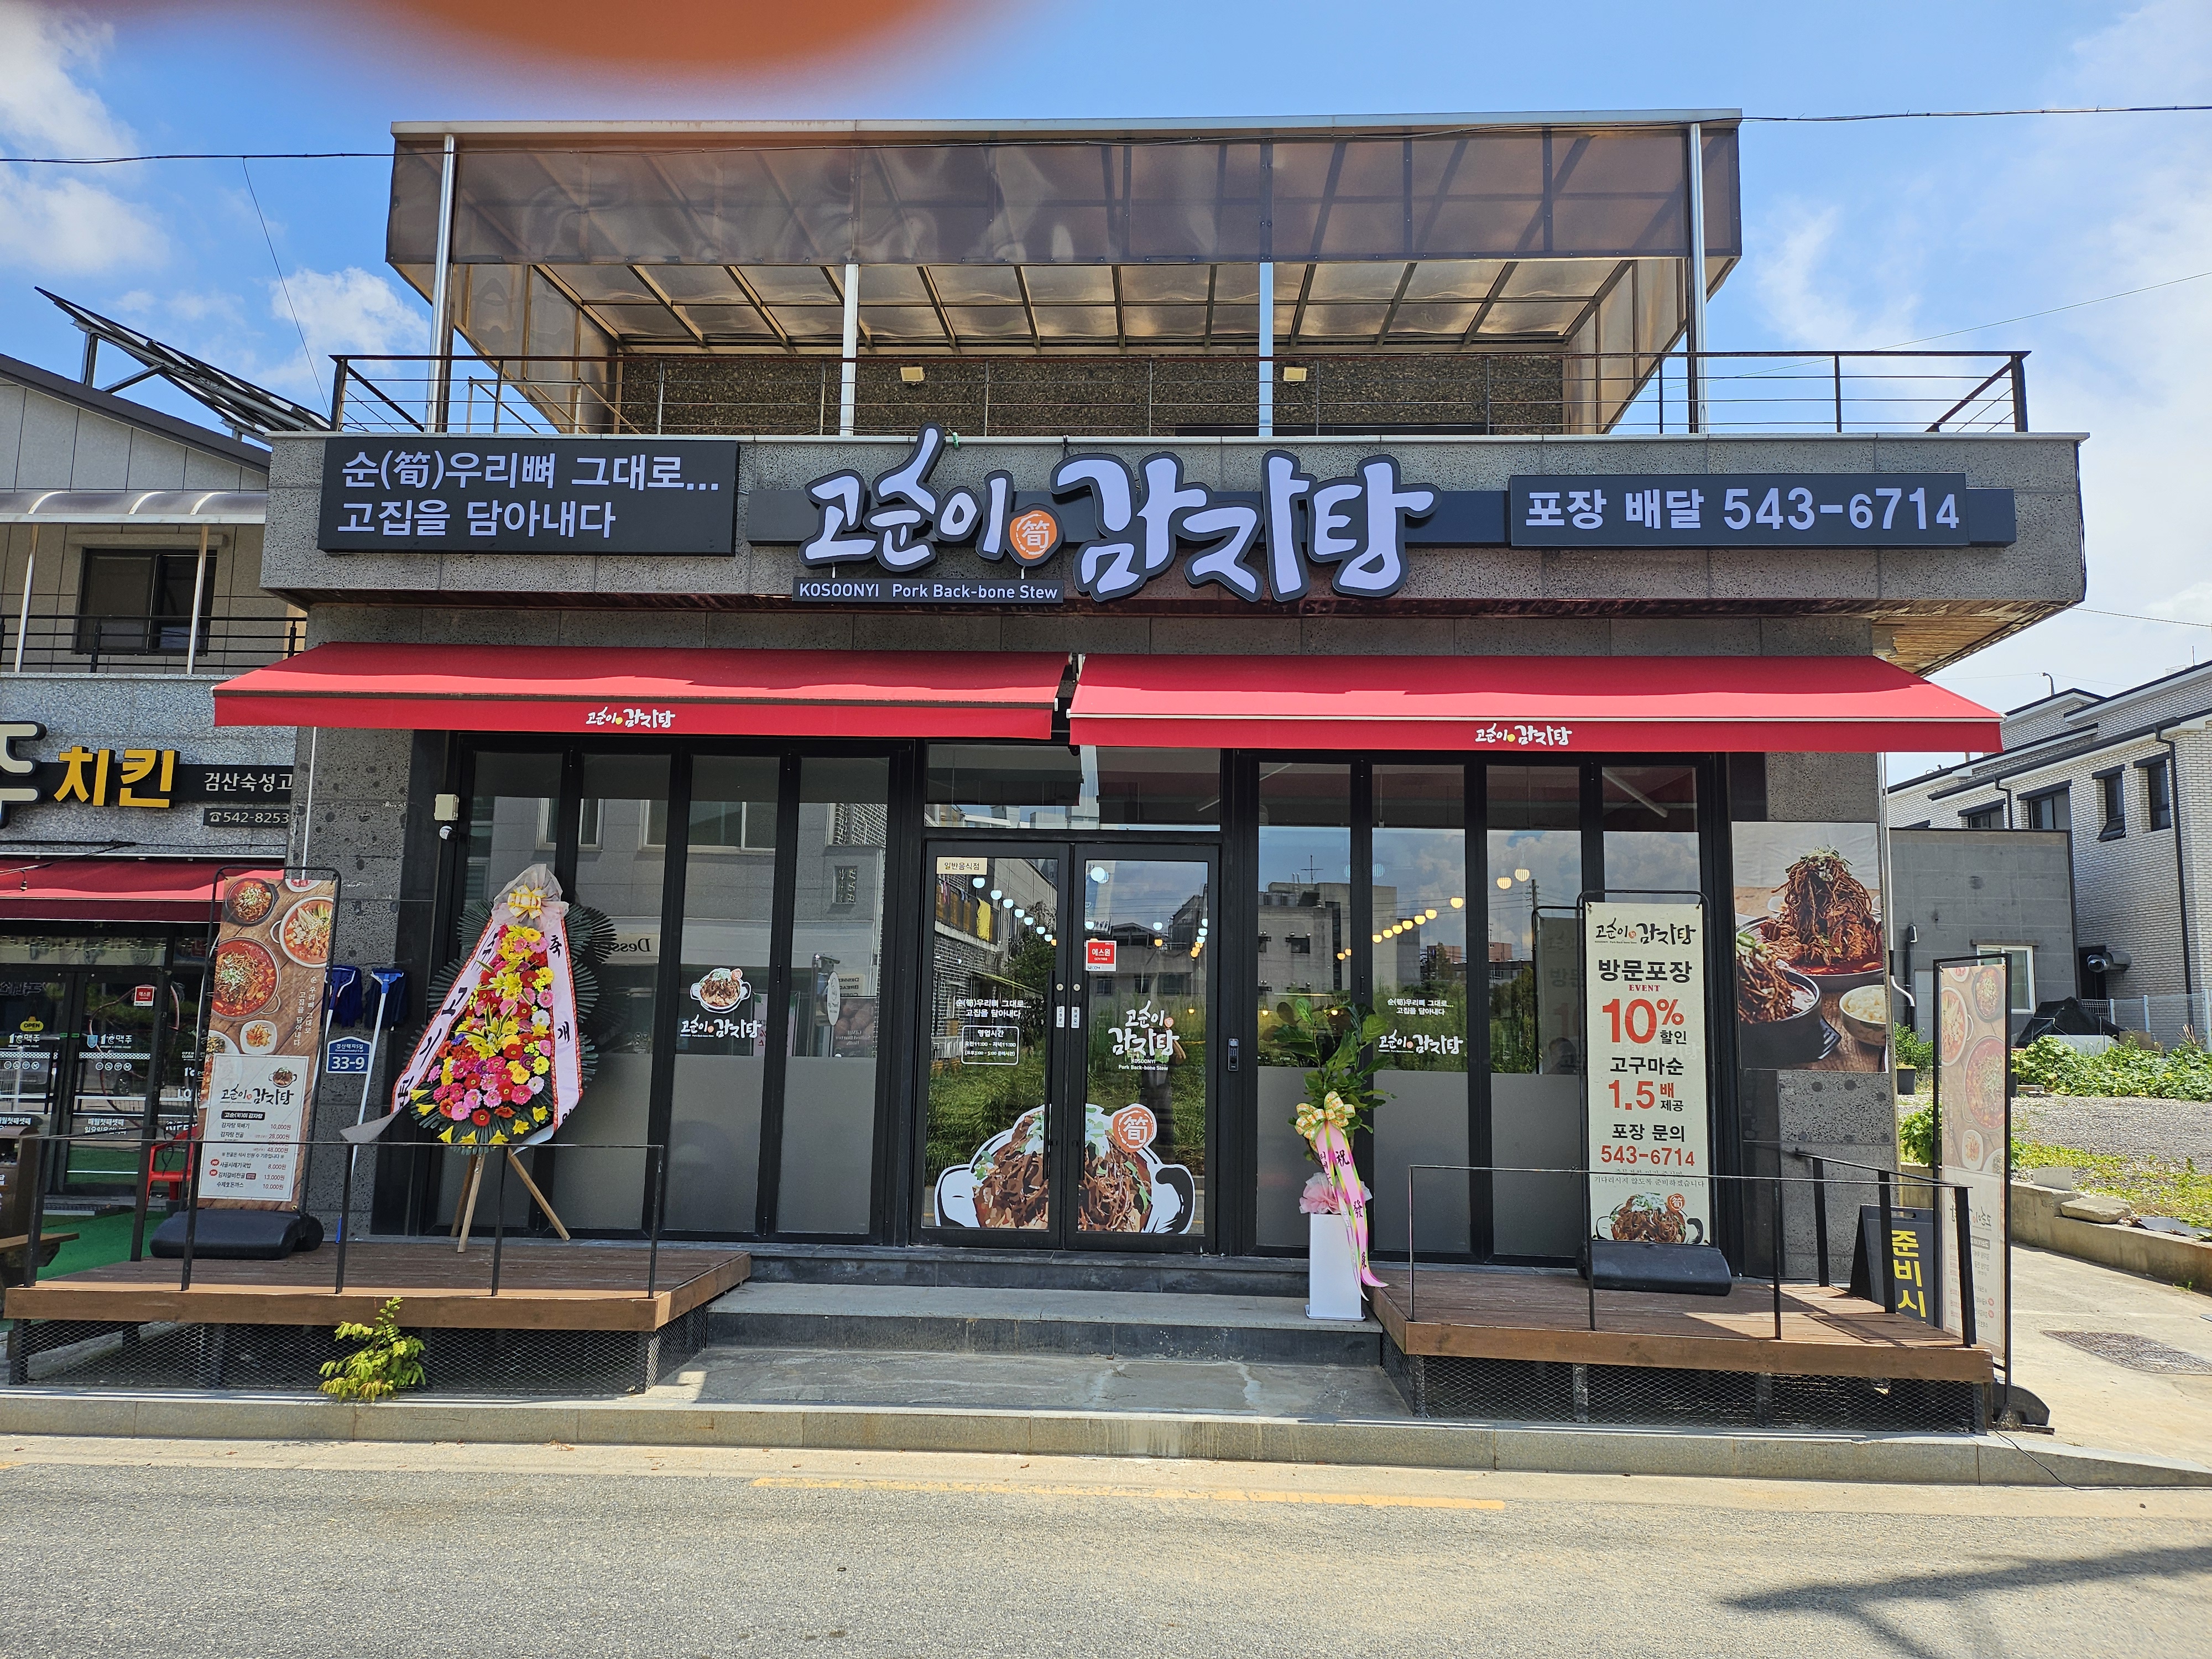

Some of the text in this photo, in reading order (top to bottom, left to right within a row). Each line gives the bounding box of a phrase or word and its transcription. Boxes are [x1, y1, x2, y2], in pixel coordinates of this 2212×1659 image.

[342, 450, 719, 491] 순(筍)우리뼈 그대로...
[337, 499, 616, 539] 고집을 담아내다
[806, 427, 1008, 566] 고순이
[1056, 455, 1437, 596] 감자탕
[1526, 487, 1959, 530] 포장 배달 543-6714
[799, 583, 1058, 599] KOSOONYI Pork Back-bone Stew
[586, 706, 676, 728] 고순이 감자탕
[1475, 722, 1573, 746] 고순이 감자탕
[54, 745, 175, 808] 치킨
[204, 773, 293, 792] 검산숙성고
[223, 812, 289, 823] 542-8253
[944, 862, 979, 870] 일반음식점
[1595, 917, 1697, 945] 고순이 감자탕
[1598, 959, 1693, 983] 방문포장
[965, 1009, 1021, 1019] 고집을 담아내다
[1125, 1000, 1165, 1029] 고순이
[1396, 1007, 1445, 1016] 고집을 담아내다
[1602, 998, 1687, 1045] 10% 할인
[681, 1014, 763, 1039] 고순이 감자탕
[978, 1029, 1005, 1038] 영업시간
[1108, 1027, 1180, 1056] 감자탕
[1379, 1029, 1464, 1055] 고순이 감자탕
[331, 1056, 365, 1070] 33-9
[1610, 1057, 1684, 1076] 고구마순
[221, 1083, 295, 1105] 고순이 감자탕
[1608, 1079, 1675, 1110] 1.5 배
[1660, 1099, 1684, 1112] 제공
[1611, 1123, 1685, 1142] 포장 문의
[1601, 1145, 1695, 1167] 543-6714
[1891, 1229, 1927, 1323] 준비시
